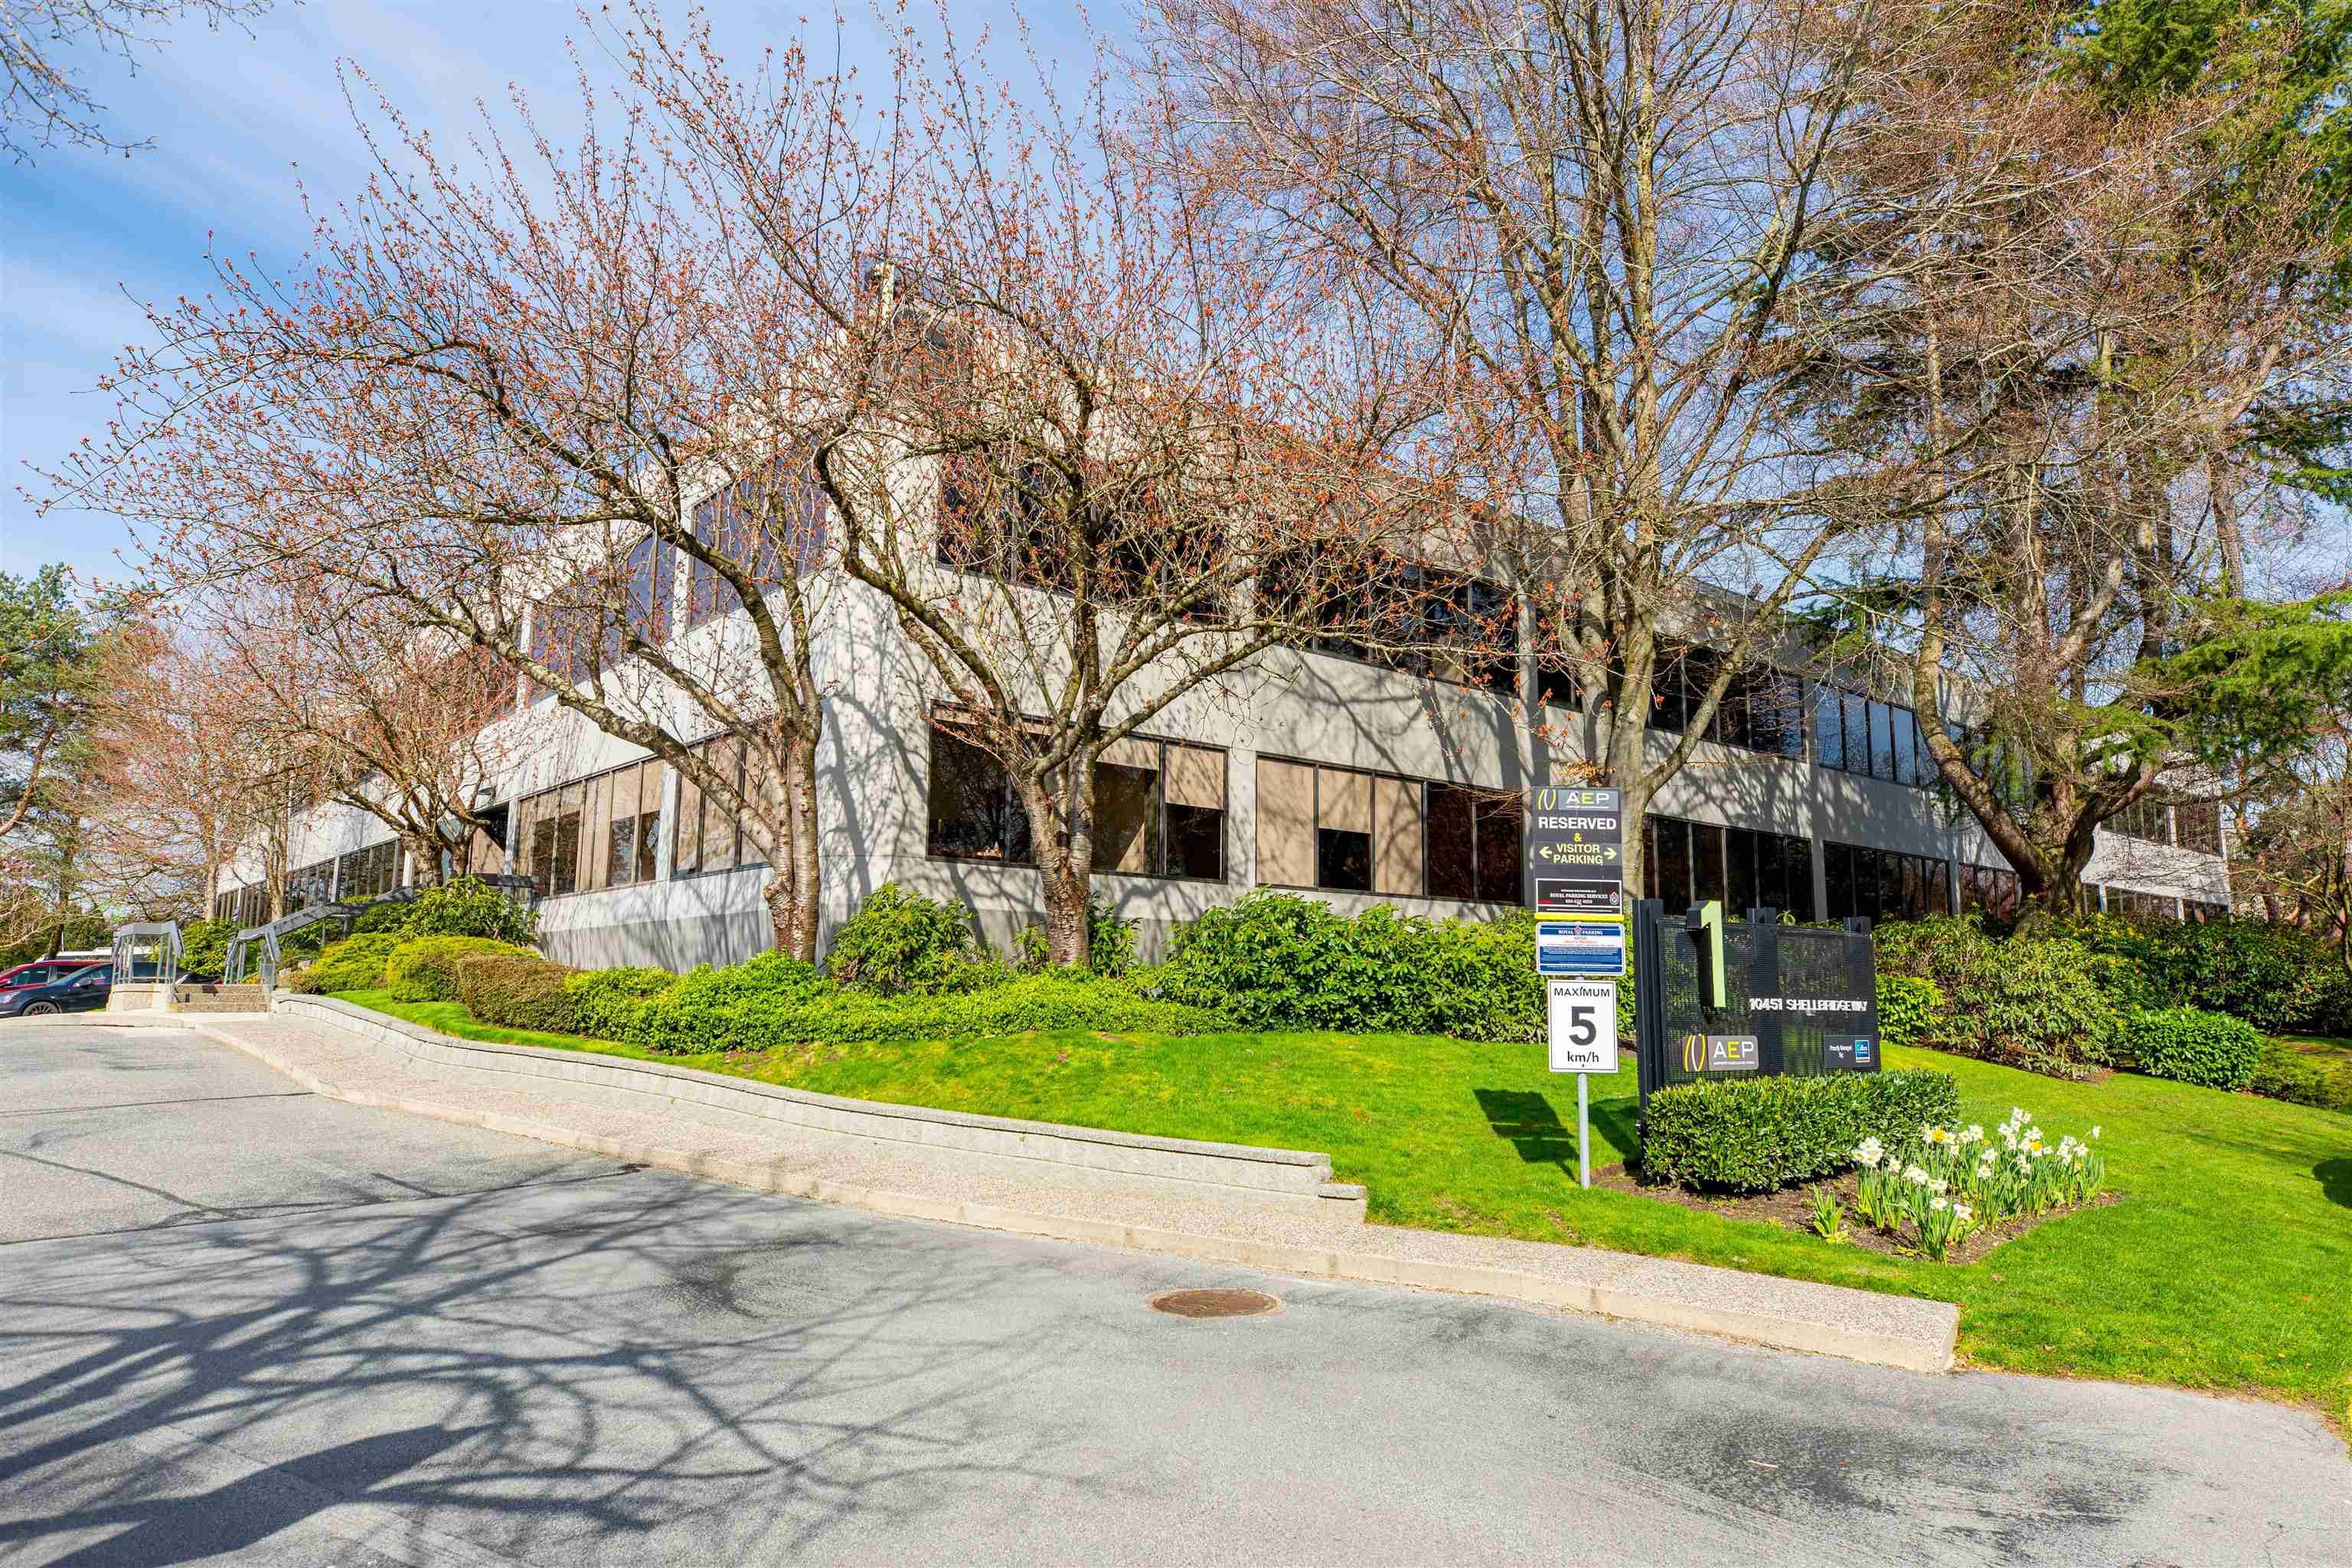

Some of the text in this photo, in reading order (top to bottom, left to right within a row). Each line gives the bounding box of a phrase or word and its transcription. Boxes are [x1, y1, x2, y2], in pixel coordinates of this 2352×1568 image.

[1566, 792, 1609, 804] AEP
[1538, 817, 1617, 830] RESERVED
[1574, 833, 1582, 842] &
[1557, 844, 1600, 853] VISITOR
[1553, 855, 1603, 864] PARKING
[1700, 900, 1726, 1008] 1
[1554, 988, 1610, 997] MAXIMUM
[1750, 998, 1783, 1011] 10451
[1569, 1006, 1596, 1046] 5
[1713, 1040, 1754, 1058] AEP
[1567, 1050, 1599, 1063] km/h
